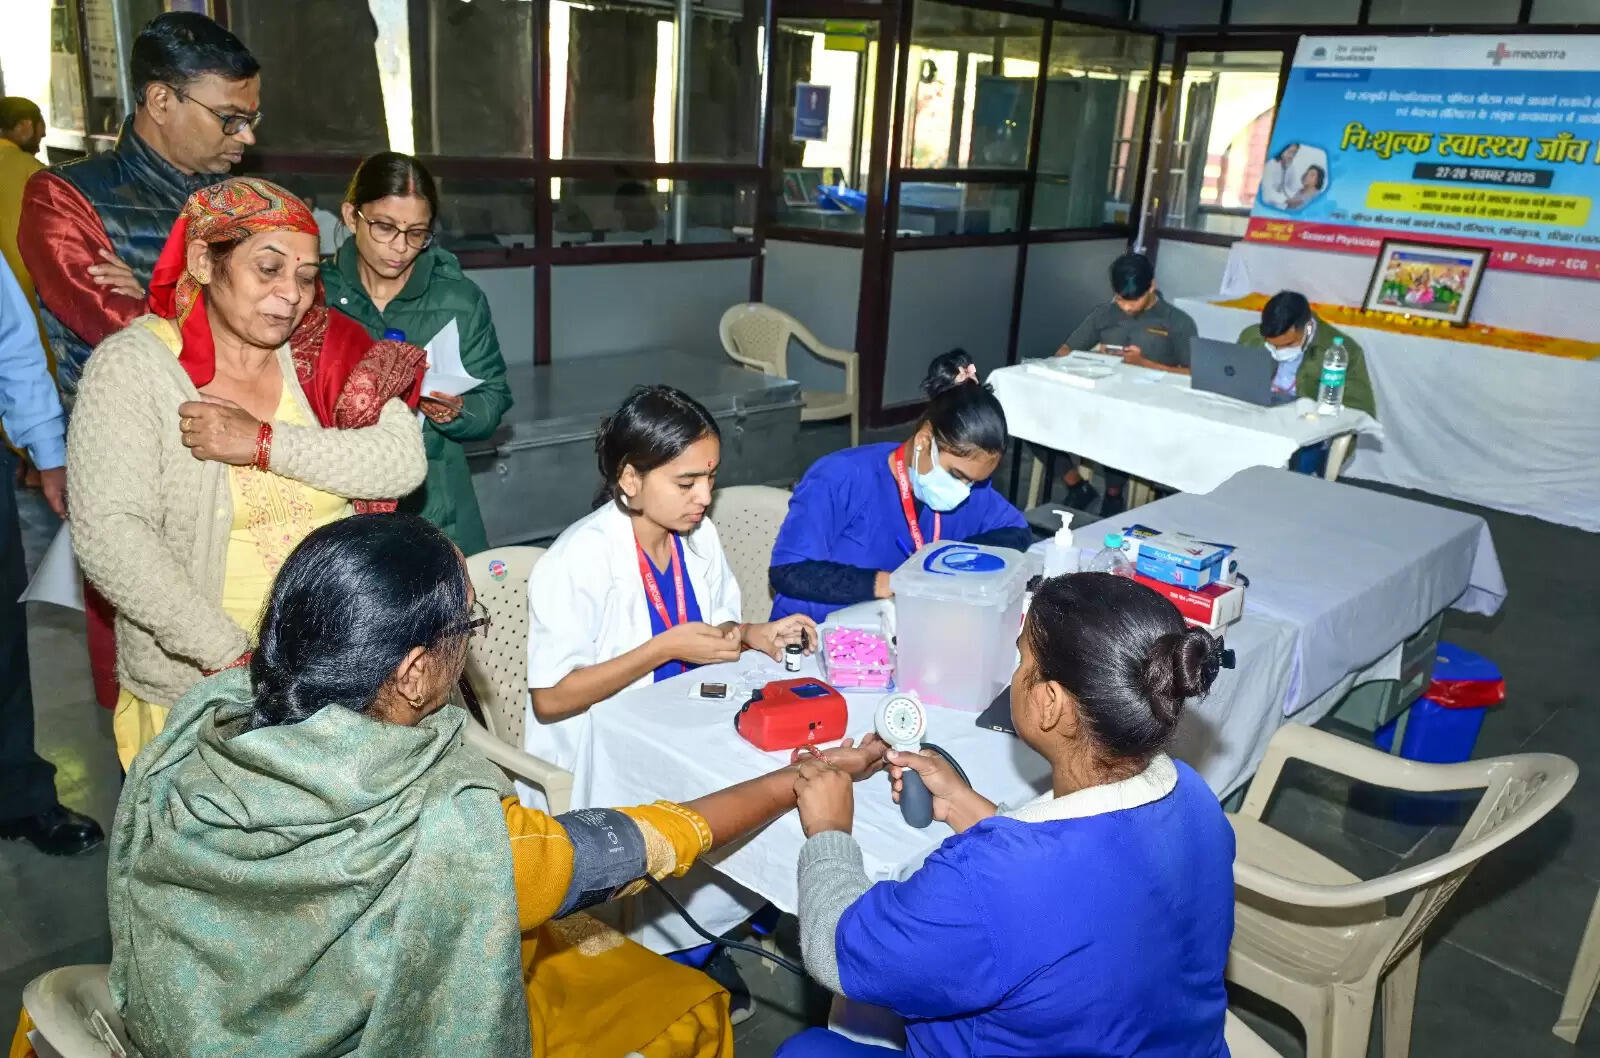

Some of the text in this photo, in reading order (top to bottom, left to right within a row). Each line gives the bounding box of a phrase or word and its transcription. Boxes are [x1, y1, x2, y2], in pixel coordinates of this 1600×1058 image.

[1438, 132, 1530, 161] स्वास्थ्य
[1506, 170, 1536, 183] 2025
[1301, 230, 1334, 243] General
[1503, 251, 1588, 270] BP Sugar ECG
[645, 571, 664, 611] medanta
